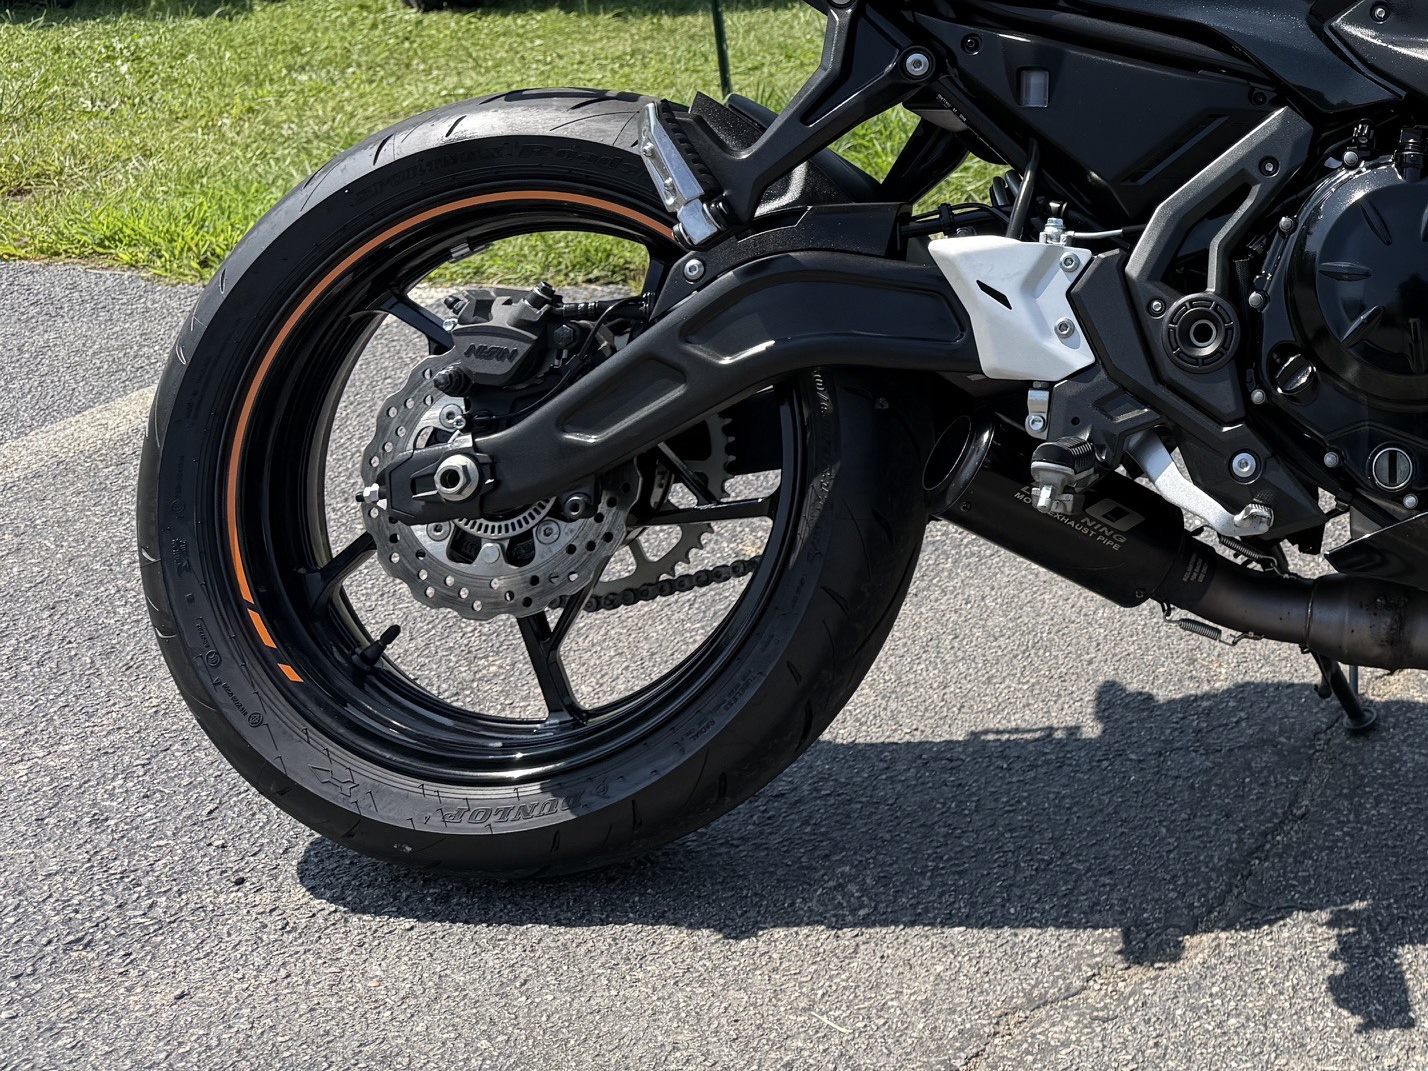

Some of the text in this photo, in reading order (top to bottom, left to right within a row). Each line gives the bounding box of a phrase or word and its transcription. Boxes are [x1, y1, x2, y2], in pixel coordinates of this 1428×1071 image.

[1048, 510, 1096, 537] EXHAUST
[1096, 534, 1122, 551] PIPE
[440, 788, 586, 825] DUNLOP
